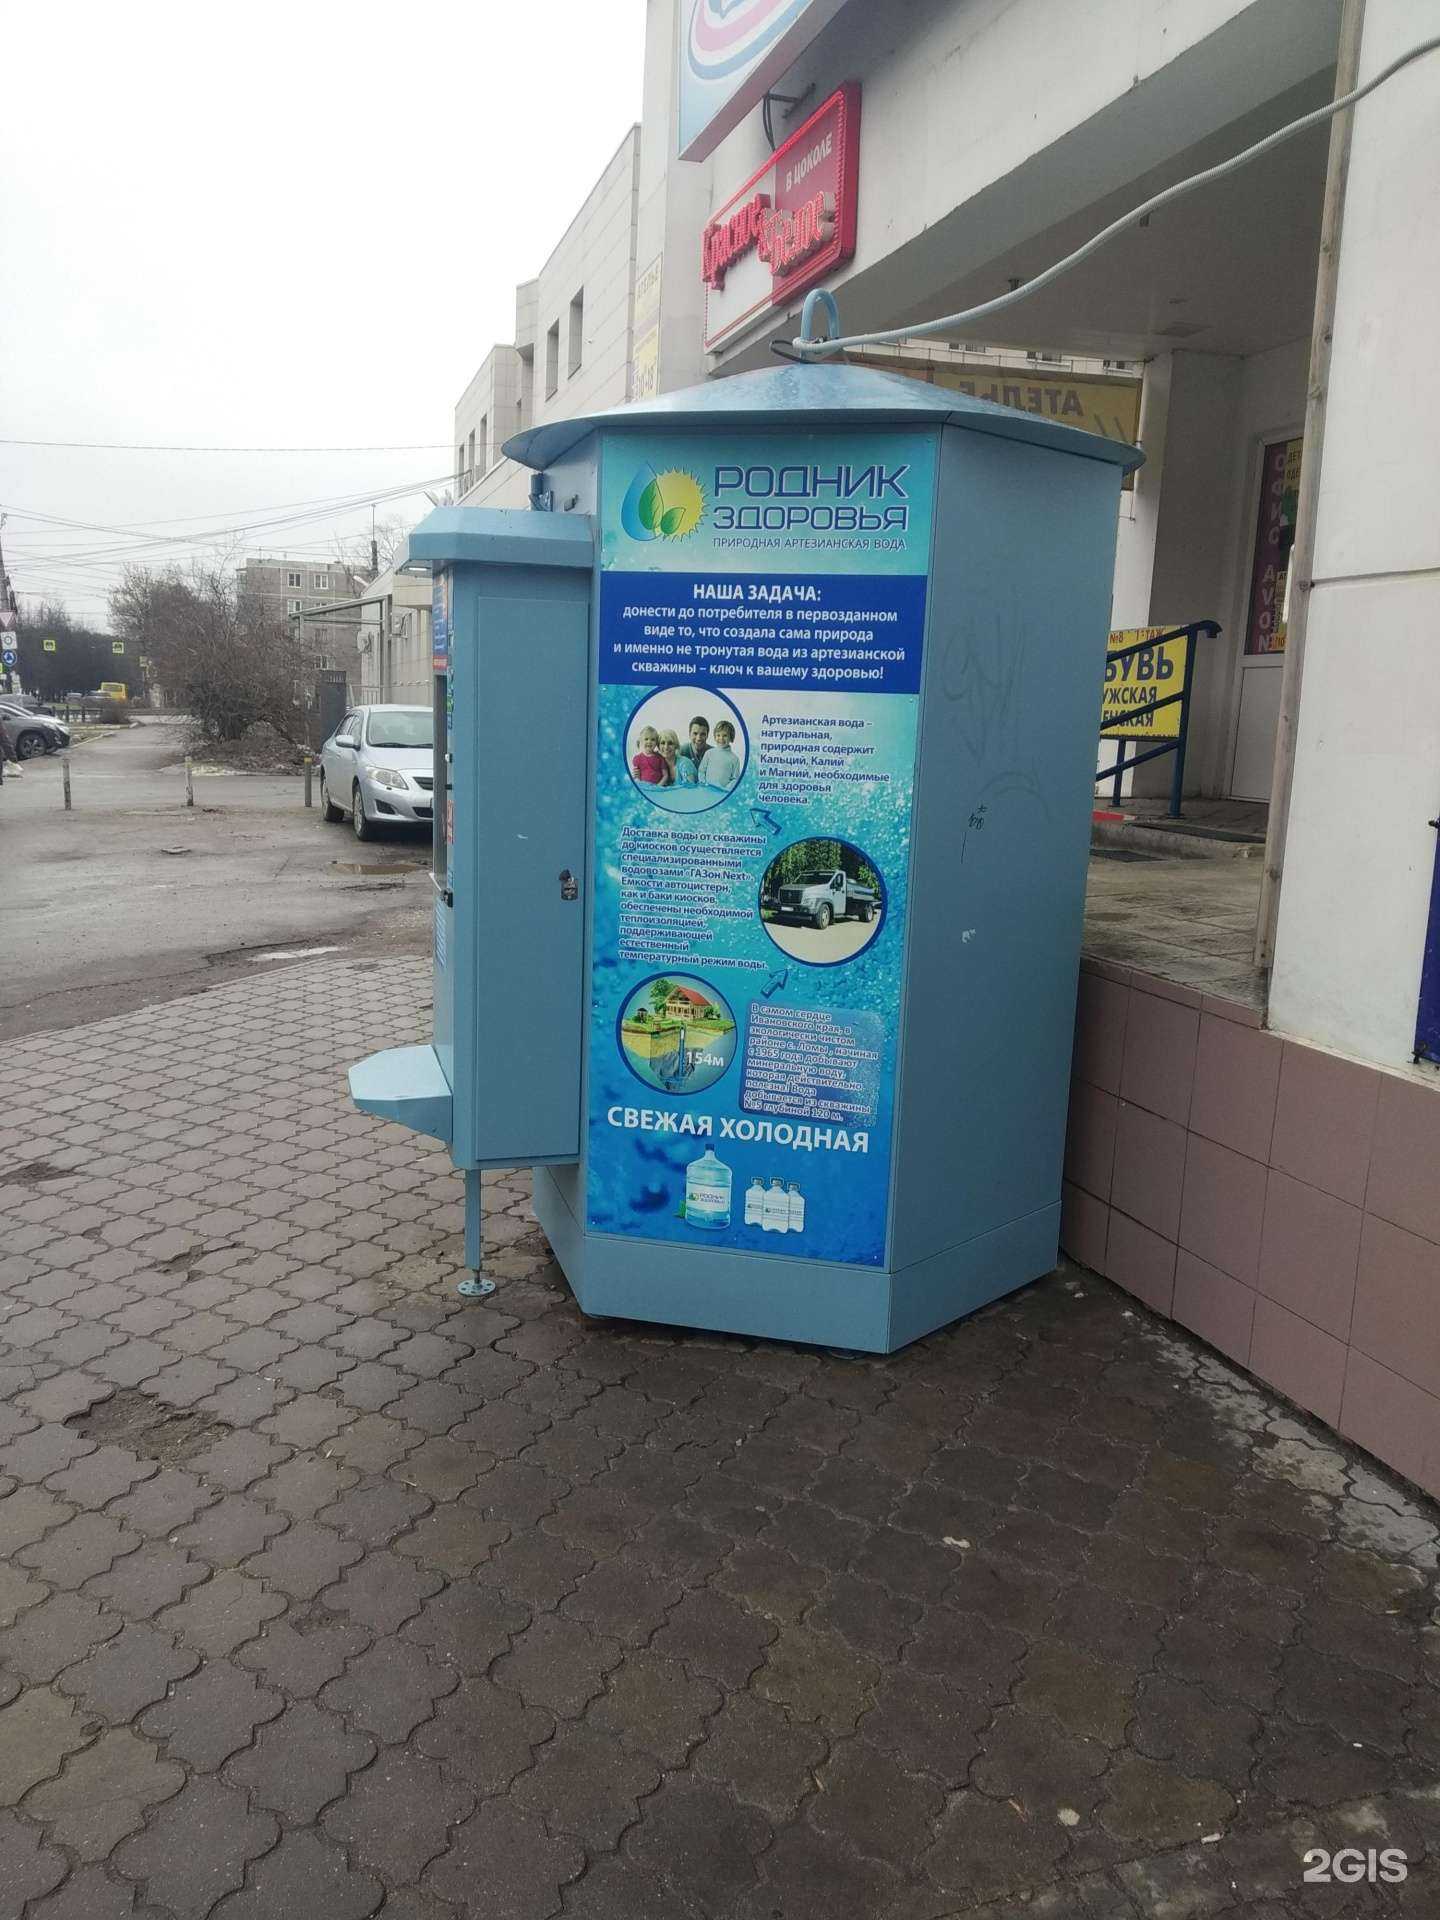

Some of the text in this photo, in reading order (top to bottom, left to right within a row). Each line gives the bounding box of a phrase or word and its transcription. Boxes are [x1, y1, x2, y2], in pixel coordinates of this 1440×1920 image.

[786, 132, 833, 192] В ЦОКОЛЕ
[714, 465, 910, 498] РОДНИК
[713, 505, 909, 531] ЗДОРОВЬЯ
[713, 537, 906, 550] ПРИРОДНАЯ АРТЕЗИАНСКАЯ ВОДА
[694, 584, 821, 602] НАША ЗАДАЧА:
[623, 604, 898, 625] донести до потребителя в первозданном
[644, 625, 874, 644] виде то, что создала сама природа
[614, 644, 905, 662] и именно не тронутая вода из артезианской
[632, 662, 696, 675] скважины
[709, 664, 743, 677] ключ
[747, 666, 754, 675] к
[757, 667, 808, 681] вашему
[811, 667, 884, 682] здоровью!
[762, 714, 837, 728] Артезианская
[838, 719, 864, 728] вода
[761, 730, 833, 741] натуральная,
[761, 743, 875, 757] природная содержит
[760, 754, 844, 767] Кальций, Калий
[768, 767, 811, 779] Магний,
[814, 771, 890, 782] необходимые
[759, 782, 831, 794] для здоровья
[622, 827, 669, 838] Доставка
[671, 833, 698, 841] воды
[713, 834, 766, 844] скважины
[621, 841, 762, 857] до киосков осуществляется
[621, 854, 742, 868] специализированными
[621, 866, 684, 878] водовозами
[621, 891, 638, 899] как
[648, 892, 673, 901] баки
[621, 903, 754, 918] обеспечены необходимой
[620, 927, 713, 940] поддерживающей
[620, 939, 689, 951] естественный
[620, 951, 699, 964] температурный
[701, 958, 736, 968] режим
[761, 1006, 793, 1017] самом
[751, 1014, 814, 1029] Ивановского
[749, 1036, 785, 1048] районе
[686, 1052, 724, 1067] 154м
[756, 1047, 779, 1058] 1965
[781, 1052, 803, 1063] года
[607, 1106, 869, 1152] СВЕЖАЯ ХОЛОДНАЯ
